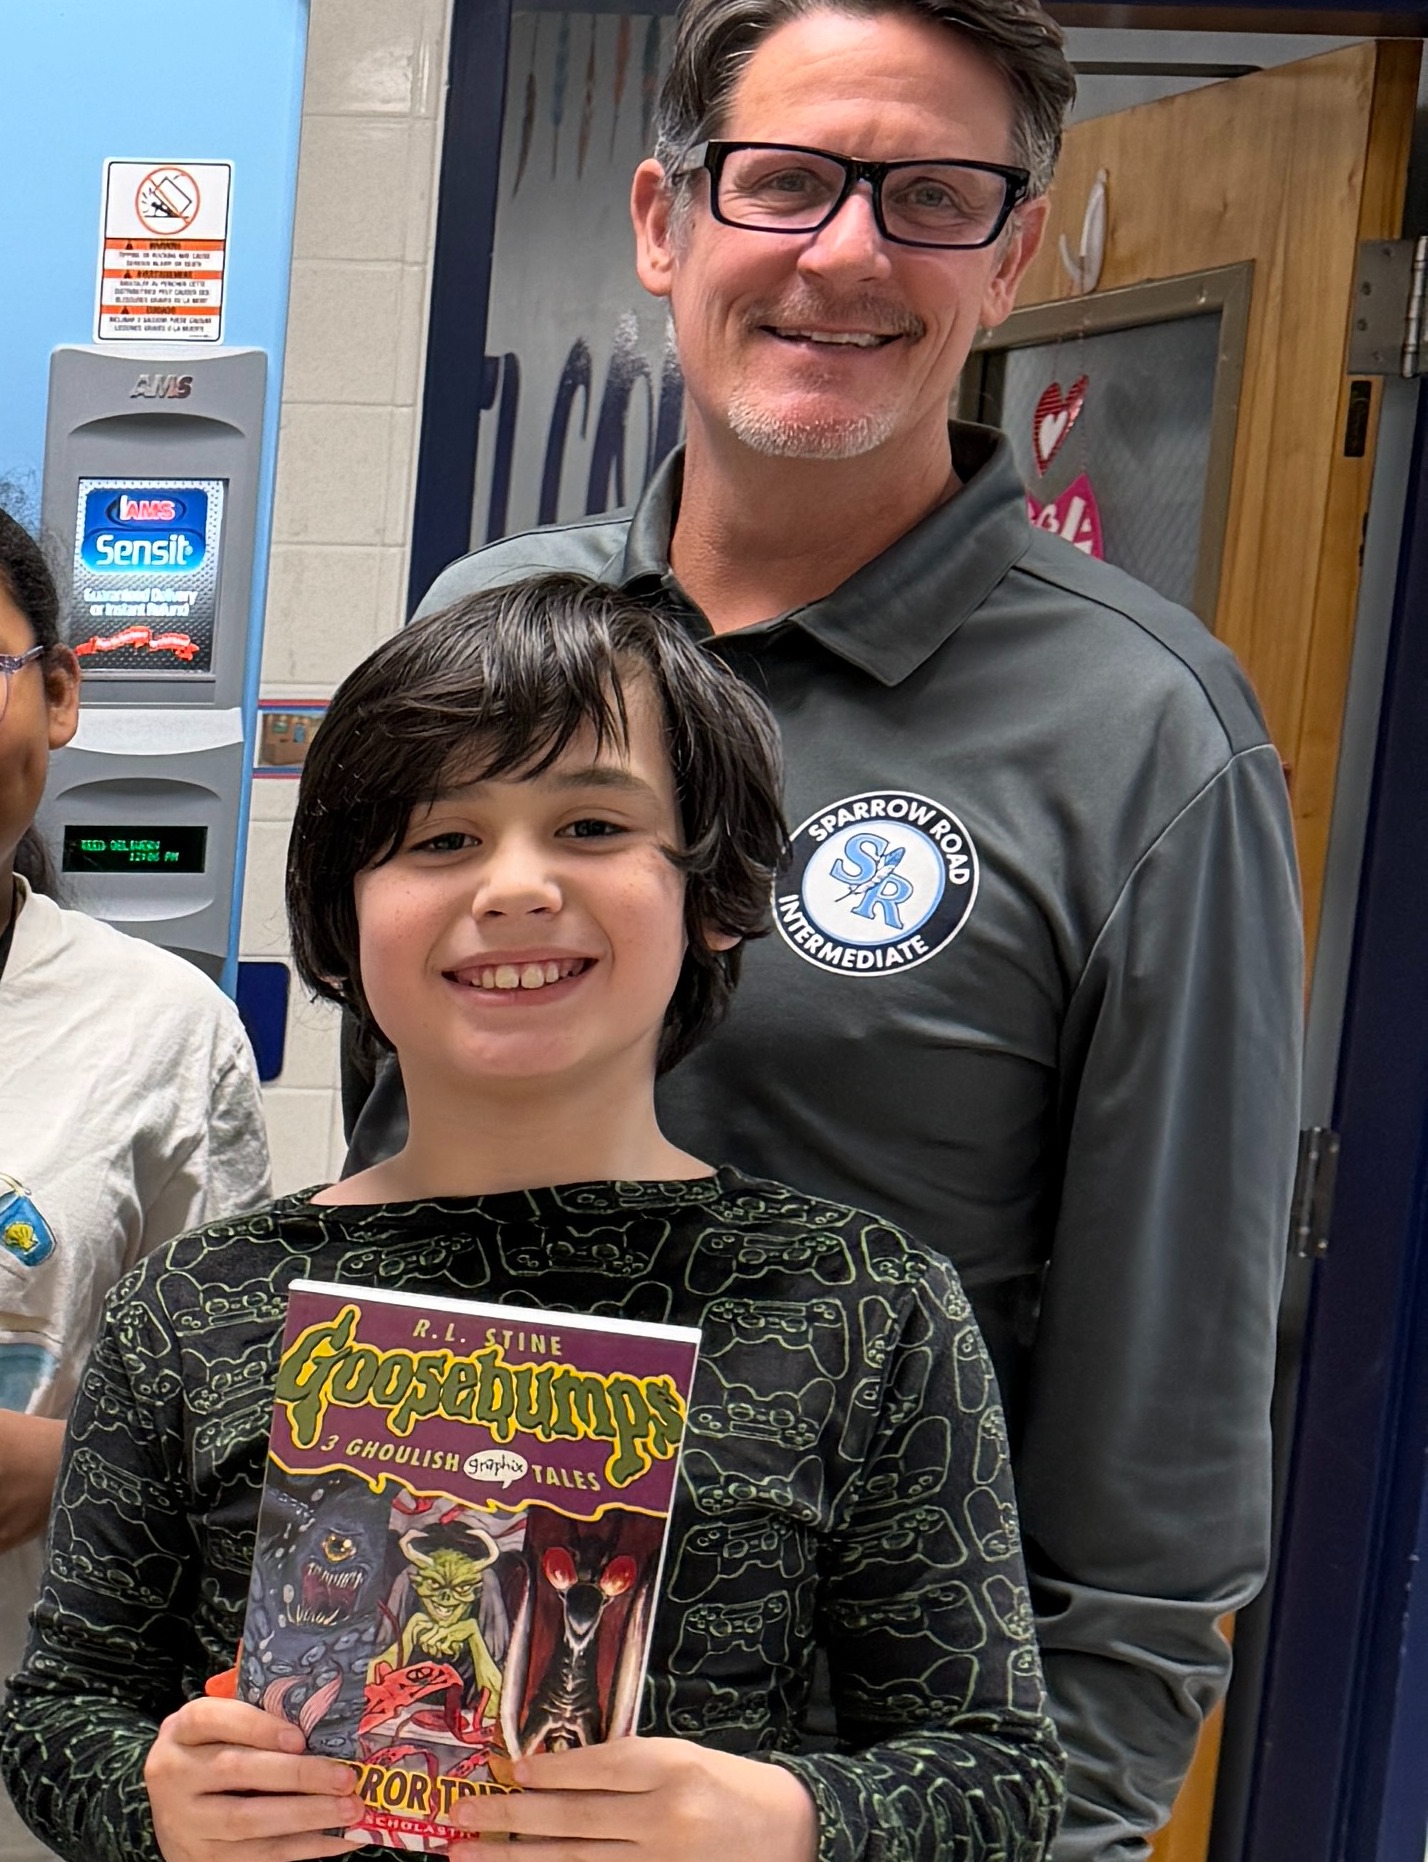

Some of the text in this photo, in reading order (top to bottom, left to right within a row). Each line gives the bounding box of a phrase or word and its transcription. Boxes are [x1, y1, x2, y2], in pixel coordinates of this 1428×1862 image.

[129, 374, 193, 399] AMS
[808, 799, 970, 886] SPARROW ROAD
[778, 894, 929, 970] INTERMEDIATE
[484, 1329, 563, 1356] STINE
[276, 1305, 687, 1487] Goosebumps
[320, 1435, 335, 1453] 3
[345, 1439, 459, 1472] GHOULISH
[531, 1464, 601, 1492] TALES
